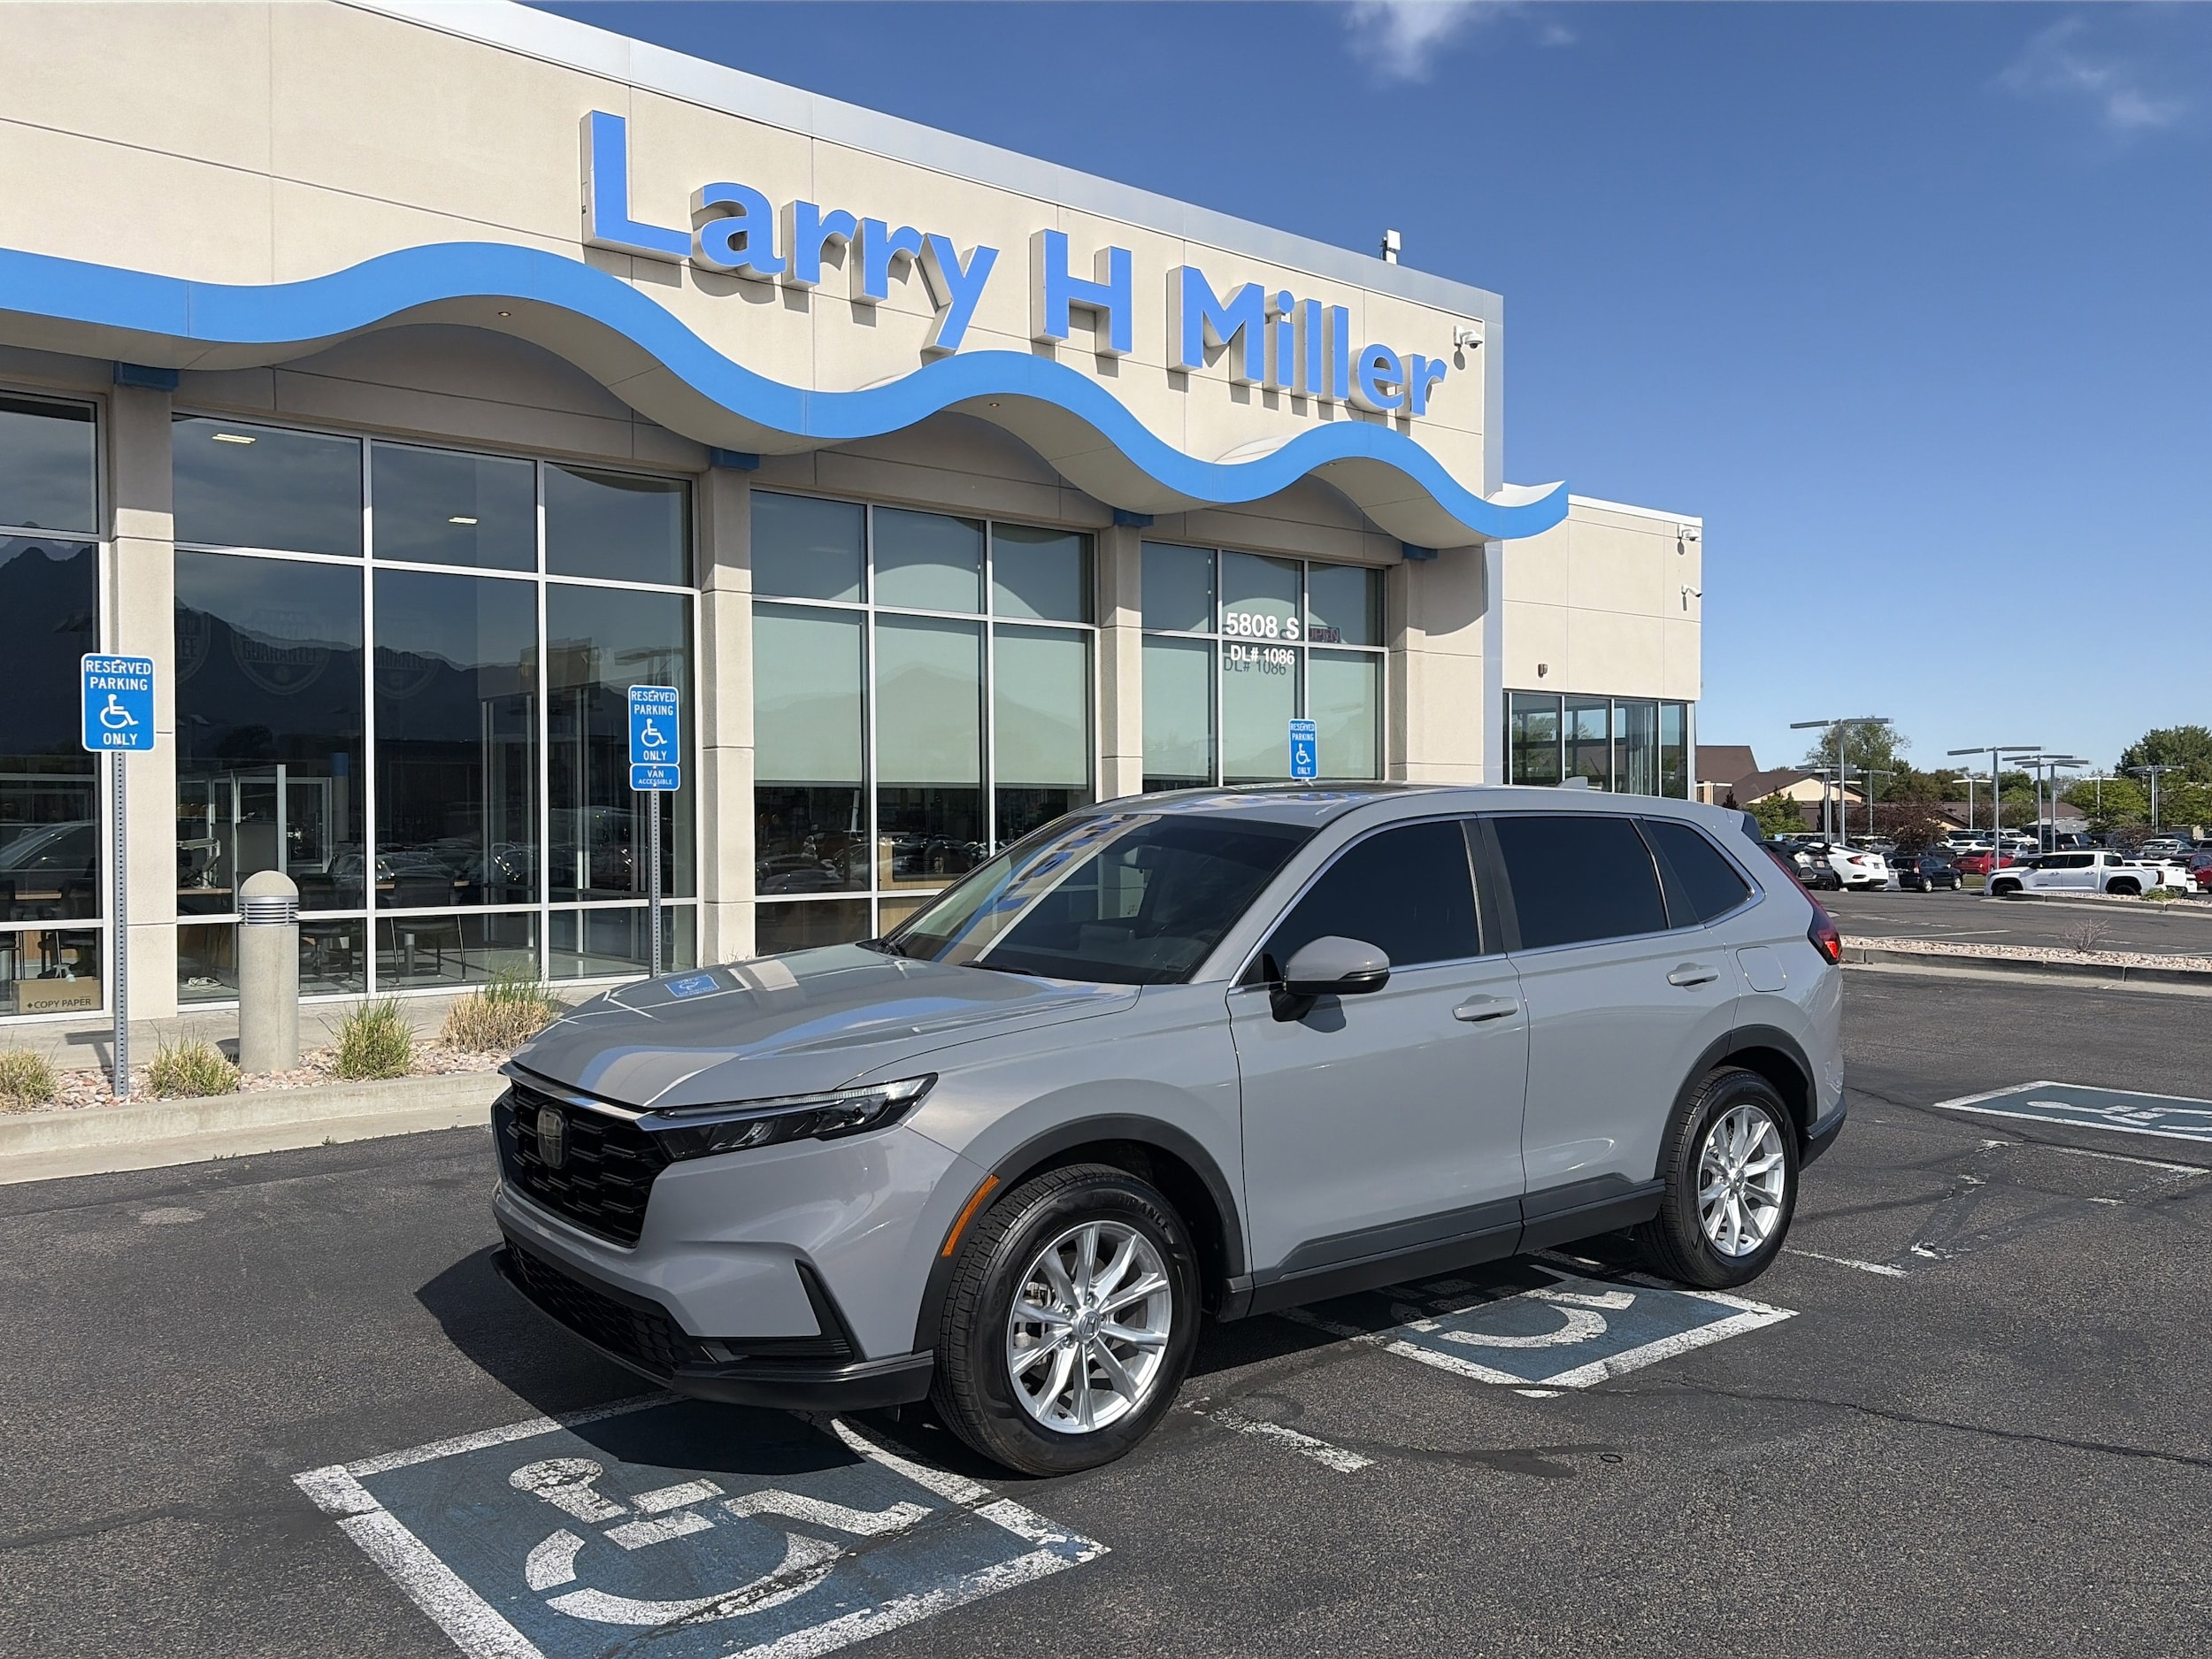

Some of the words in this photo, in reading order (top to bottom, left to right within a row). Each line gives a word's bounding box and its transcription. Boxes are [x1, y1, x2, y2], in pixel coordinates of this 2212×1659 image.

[584, 110, 1000, 355] Larry
[1035, 227, 1133, 357] H
[1171, 265, 1447, 417] Miller
[1225, 611, 1278, 638] 5808
[1286, 617, 1300, 640] S
[1231, 644, 1259, 662] DL#
[1263, 648, 1295, 665] 1086
[86, 660, 151, 675] RESERVED
[90, 677, 148, 691] PARKING
[631, 690, 676, 703] RESERVED
[634, 704, 673, 716] PARKING
[103, 733, 138, 746] ONLY
[1292, 733, 1314, 741] PARKING
[643, 750, 667, 761] ONLY
[34, 1000, 60, 1009] COPY
[61, 998, 91, 1007] PAPER
